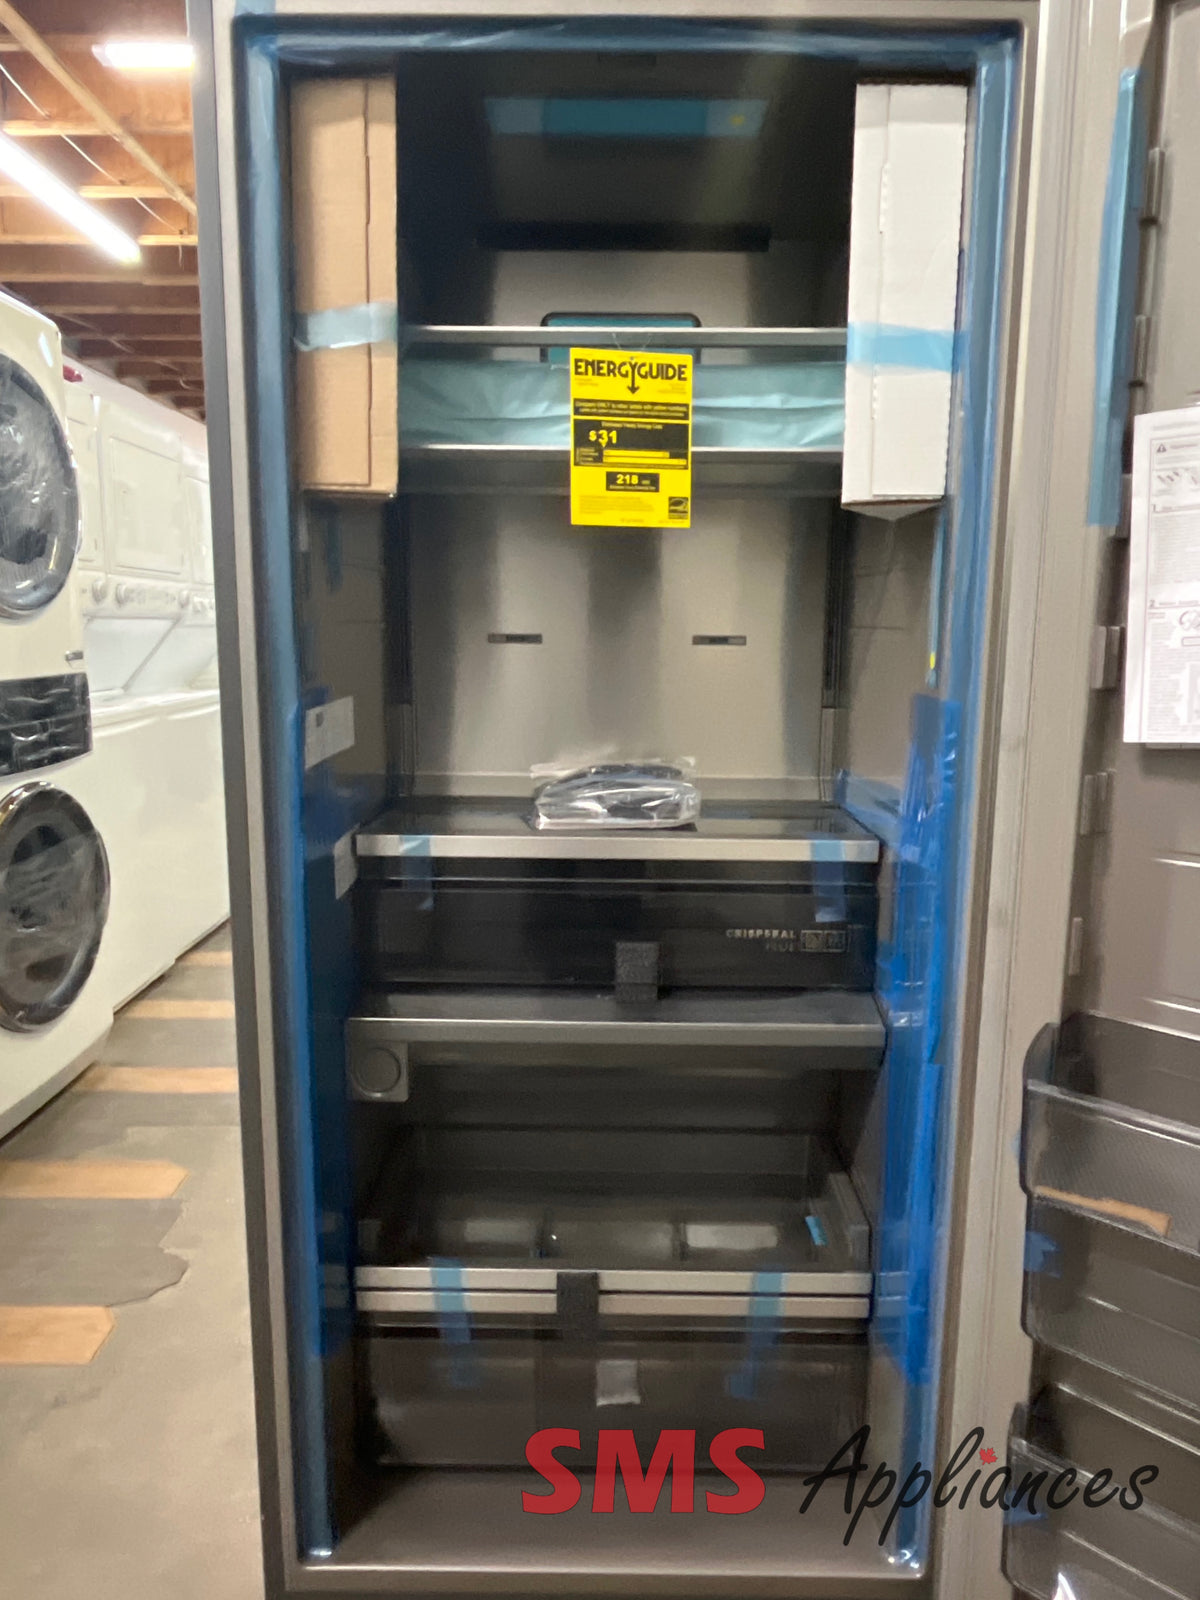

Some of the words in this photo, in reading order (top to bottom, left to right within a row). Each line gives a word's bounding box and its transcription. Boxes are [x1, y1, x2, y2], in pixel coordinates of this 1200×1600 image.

[574, 358, 688, 382] ENERGYGUIDE
[588, 430, 618, 444] $31
[616, 474, 639, 485] 218
